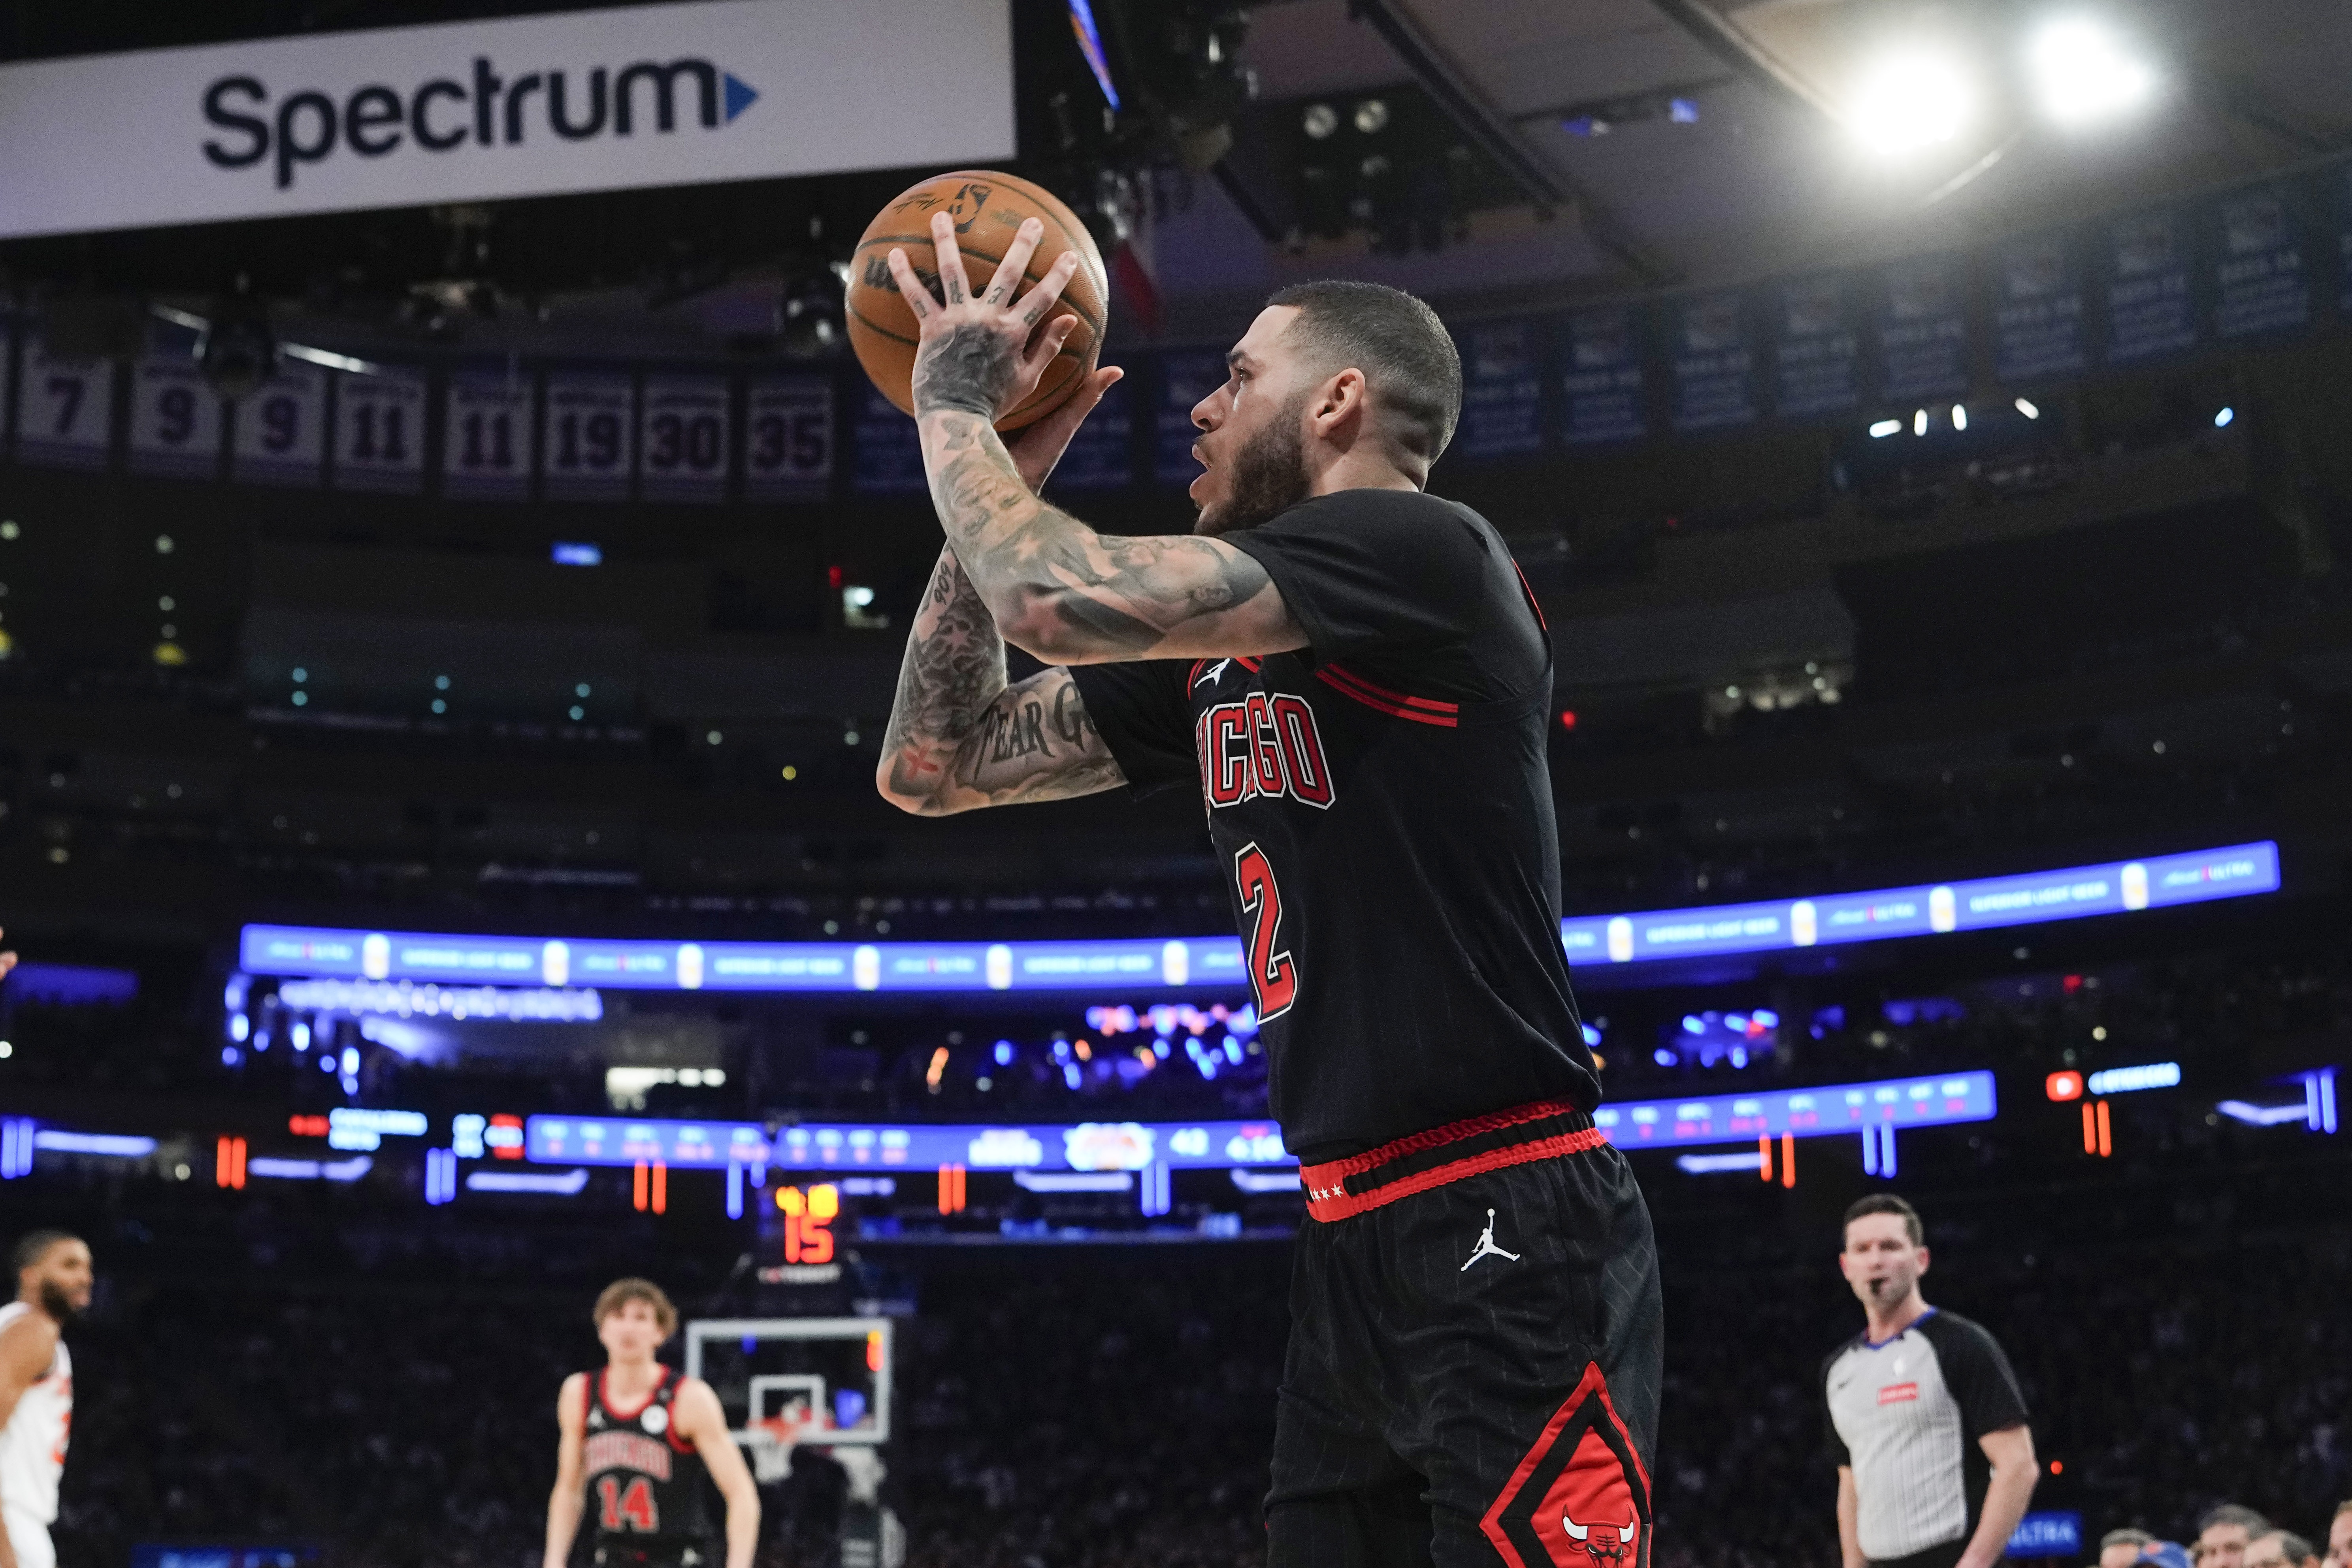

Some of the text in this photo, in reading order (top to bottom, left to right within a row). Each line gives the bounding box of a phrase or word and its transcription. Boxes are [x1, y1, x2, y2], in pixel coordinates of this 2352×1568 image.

[201, 55, 719, 189] Spectrum
[46, 376, 84, 435] 7
[158, 387, 198, 444] 9
[261, 397, 299, 453] 9
[351, 404, 406, 461] 11
[460, 411, 514, 470] 11
[556, 413, 620, 469] 19
[649, 413, 724, 470] 30
[754, 413, 827, 470] 35
[1054, 681, 1097, 752] G
[1235, 840, 1298, 1026] 2
[785, 1213, 834, 1264] 15
[597, 1474, 660, 1533] 14
